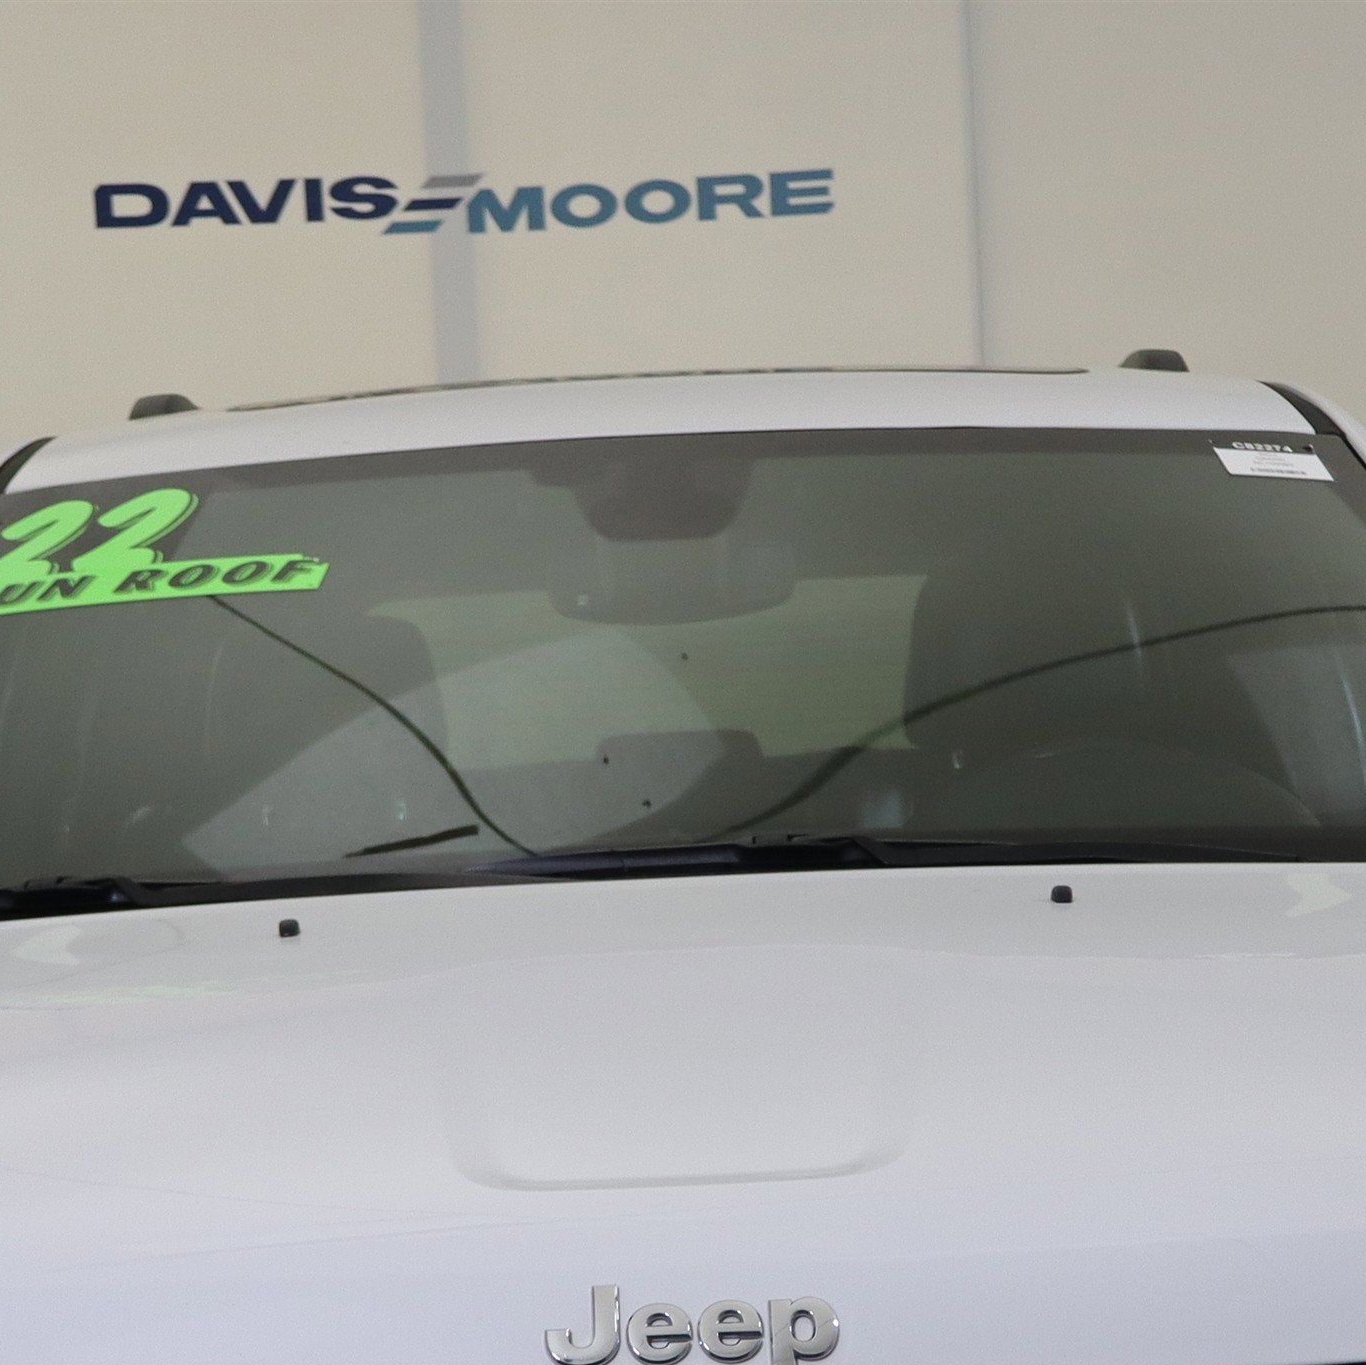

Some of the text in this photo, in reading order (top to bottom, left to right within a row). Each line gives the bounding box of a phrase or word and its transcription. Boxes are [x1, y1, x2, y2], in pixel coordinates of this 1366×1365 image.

[93, 168, 835, 234] DAVIS MOORE
[113, 559, 320, 595] ROOF
